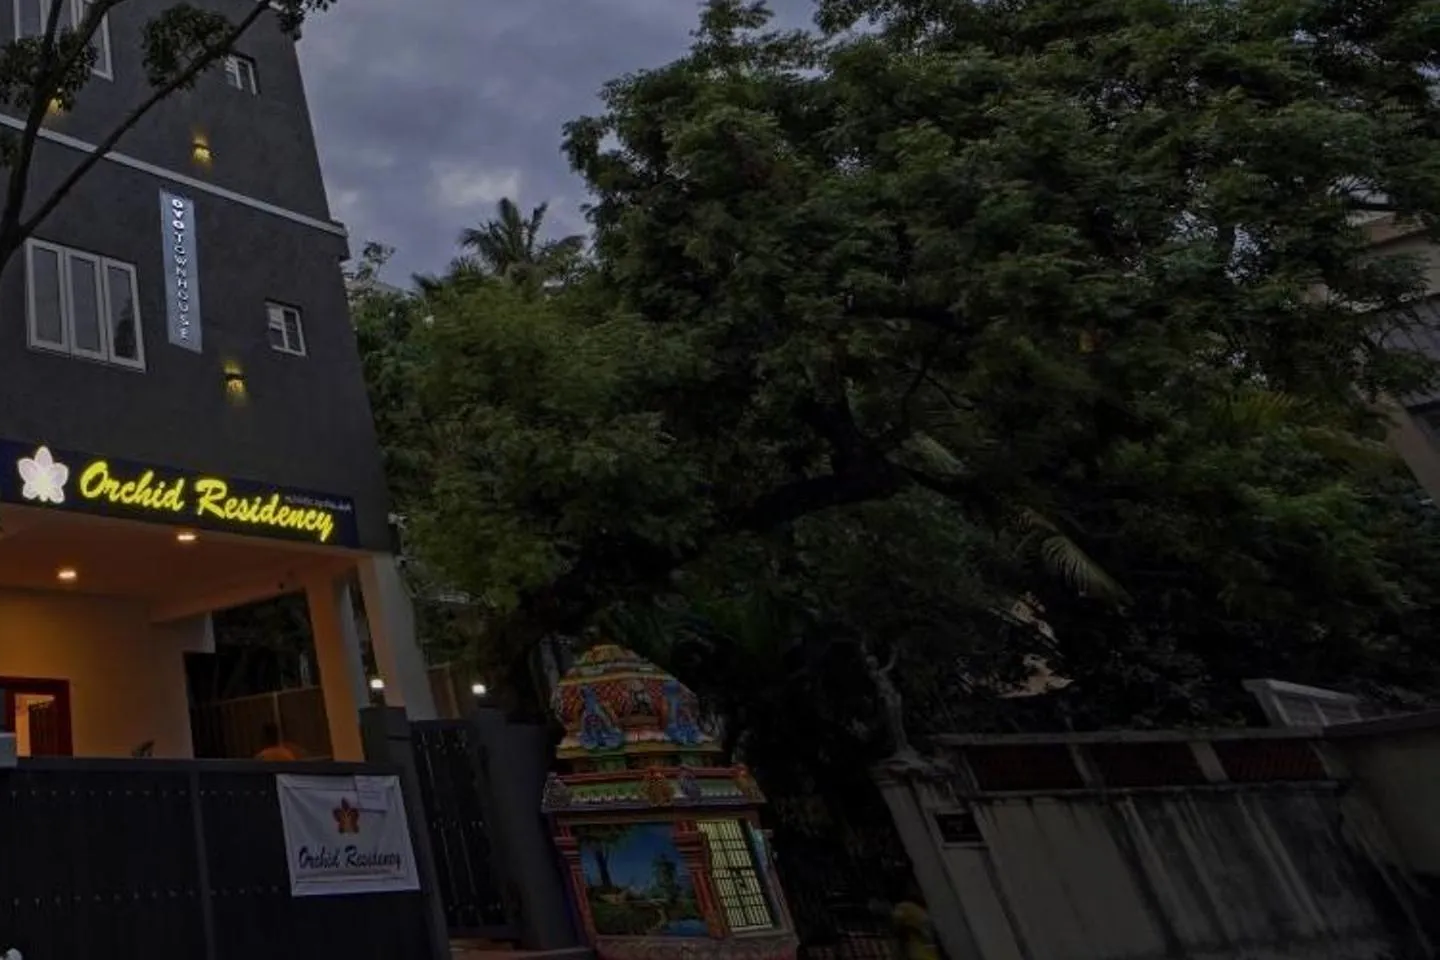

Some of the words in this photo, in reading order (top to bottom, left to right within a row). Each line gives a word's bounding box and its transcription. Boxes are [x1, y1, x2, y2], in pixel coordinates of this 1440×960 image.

[79, 458, 186, 512] Orchid
[193, 477, 336, 542] Residency
[299, 845, 340, 869] Orchid
[344, 845, 400, 870] Residency
